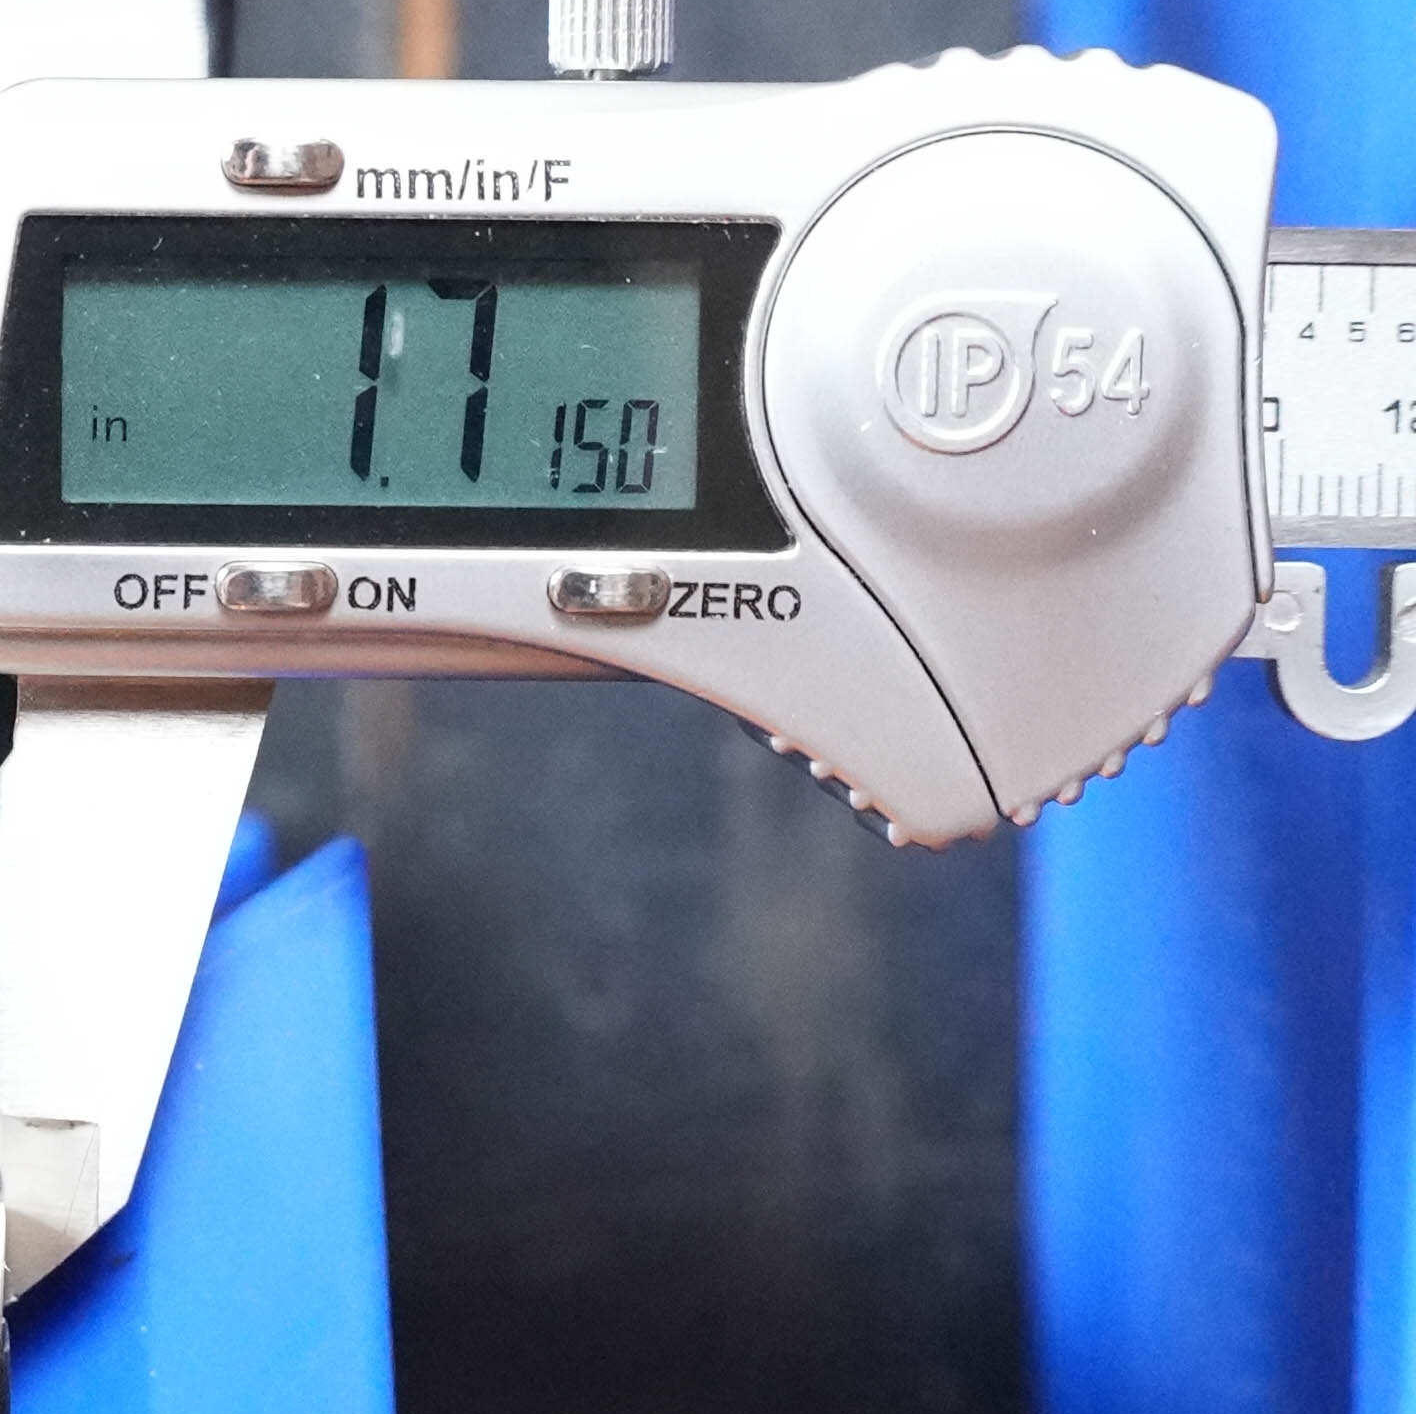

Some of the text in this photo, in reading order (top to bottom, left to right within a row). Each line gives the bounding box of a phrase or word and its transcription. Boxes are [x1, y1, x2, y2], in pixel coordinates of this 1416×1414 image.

[356, 159, 571, 202] mm/in/F
[1297, 321, 1416, 343] 4 5 6
[918, 326, 1151, 419] IP 54
[91, 405, 128, 443] in
[114, 574, 416, 613] OFF ON
[668, 581, 801, 621] ZERO
